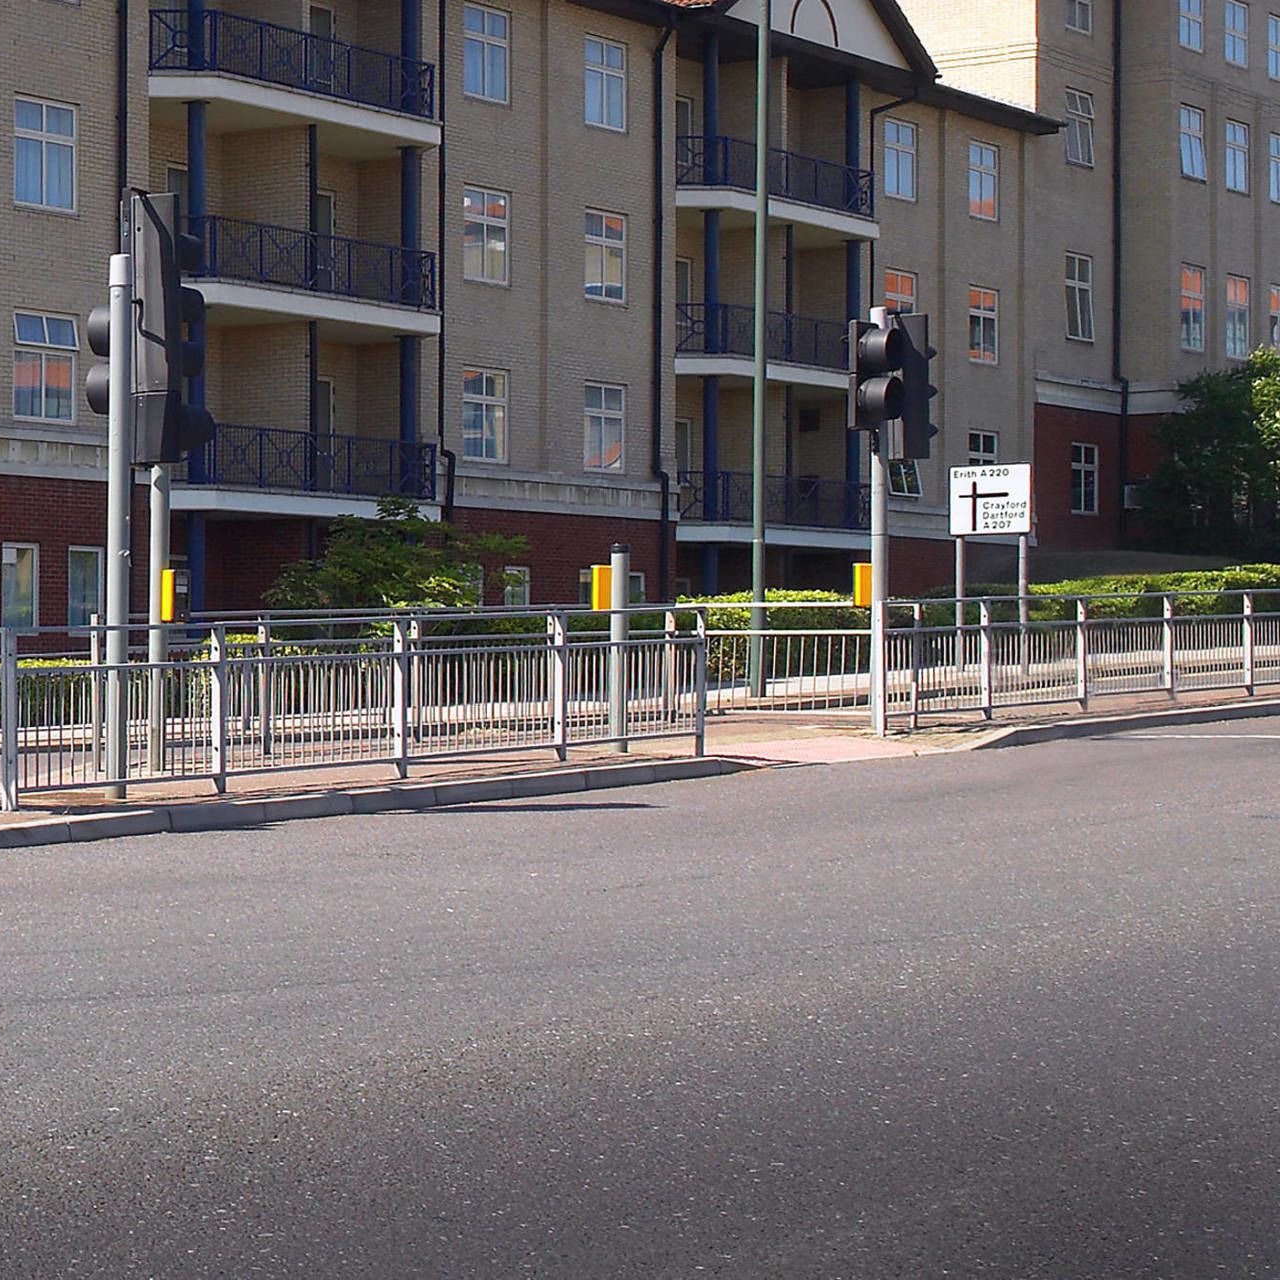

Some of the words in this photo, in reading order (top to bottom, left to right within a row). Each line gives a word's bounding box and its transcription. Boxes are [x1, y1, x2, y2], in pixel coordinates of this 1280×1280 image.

[953, 470, 977, 479] Erith
[982, 501, 1027, 510] Crayford
[982, 511, 1025, 520] Dartford
